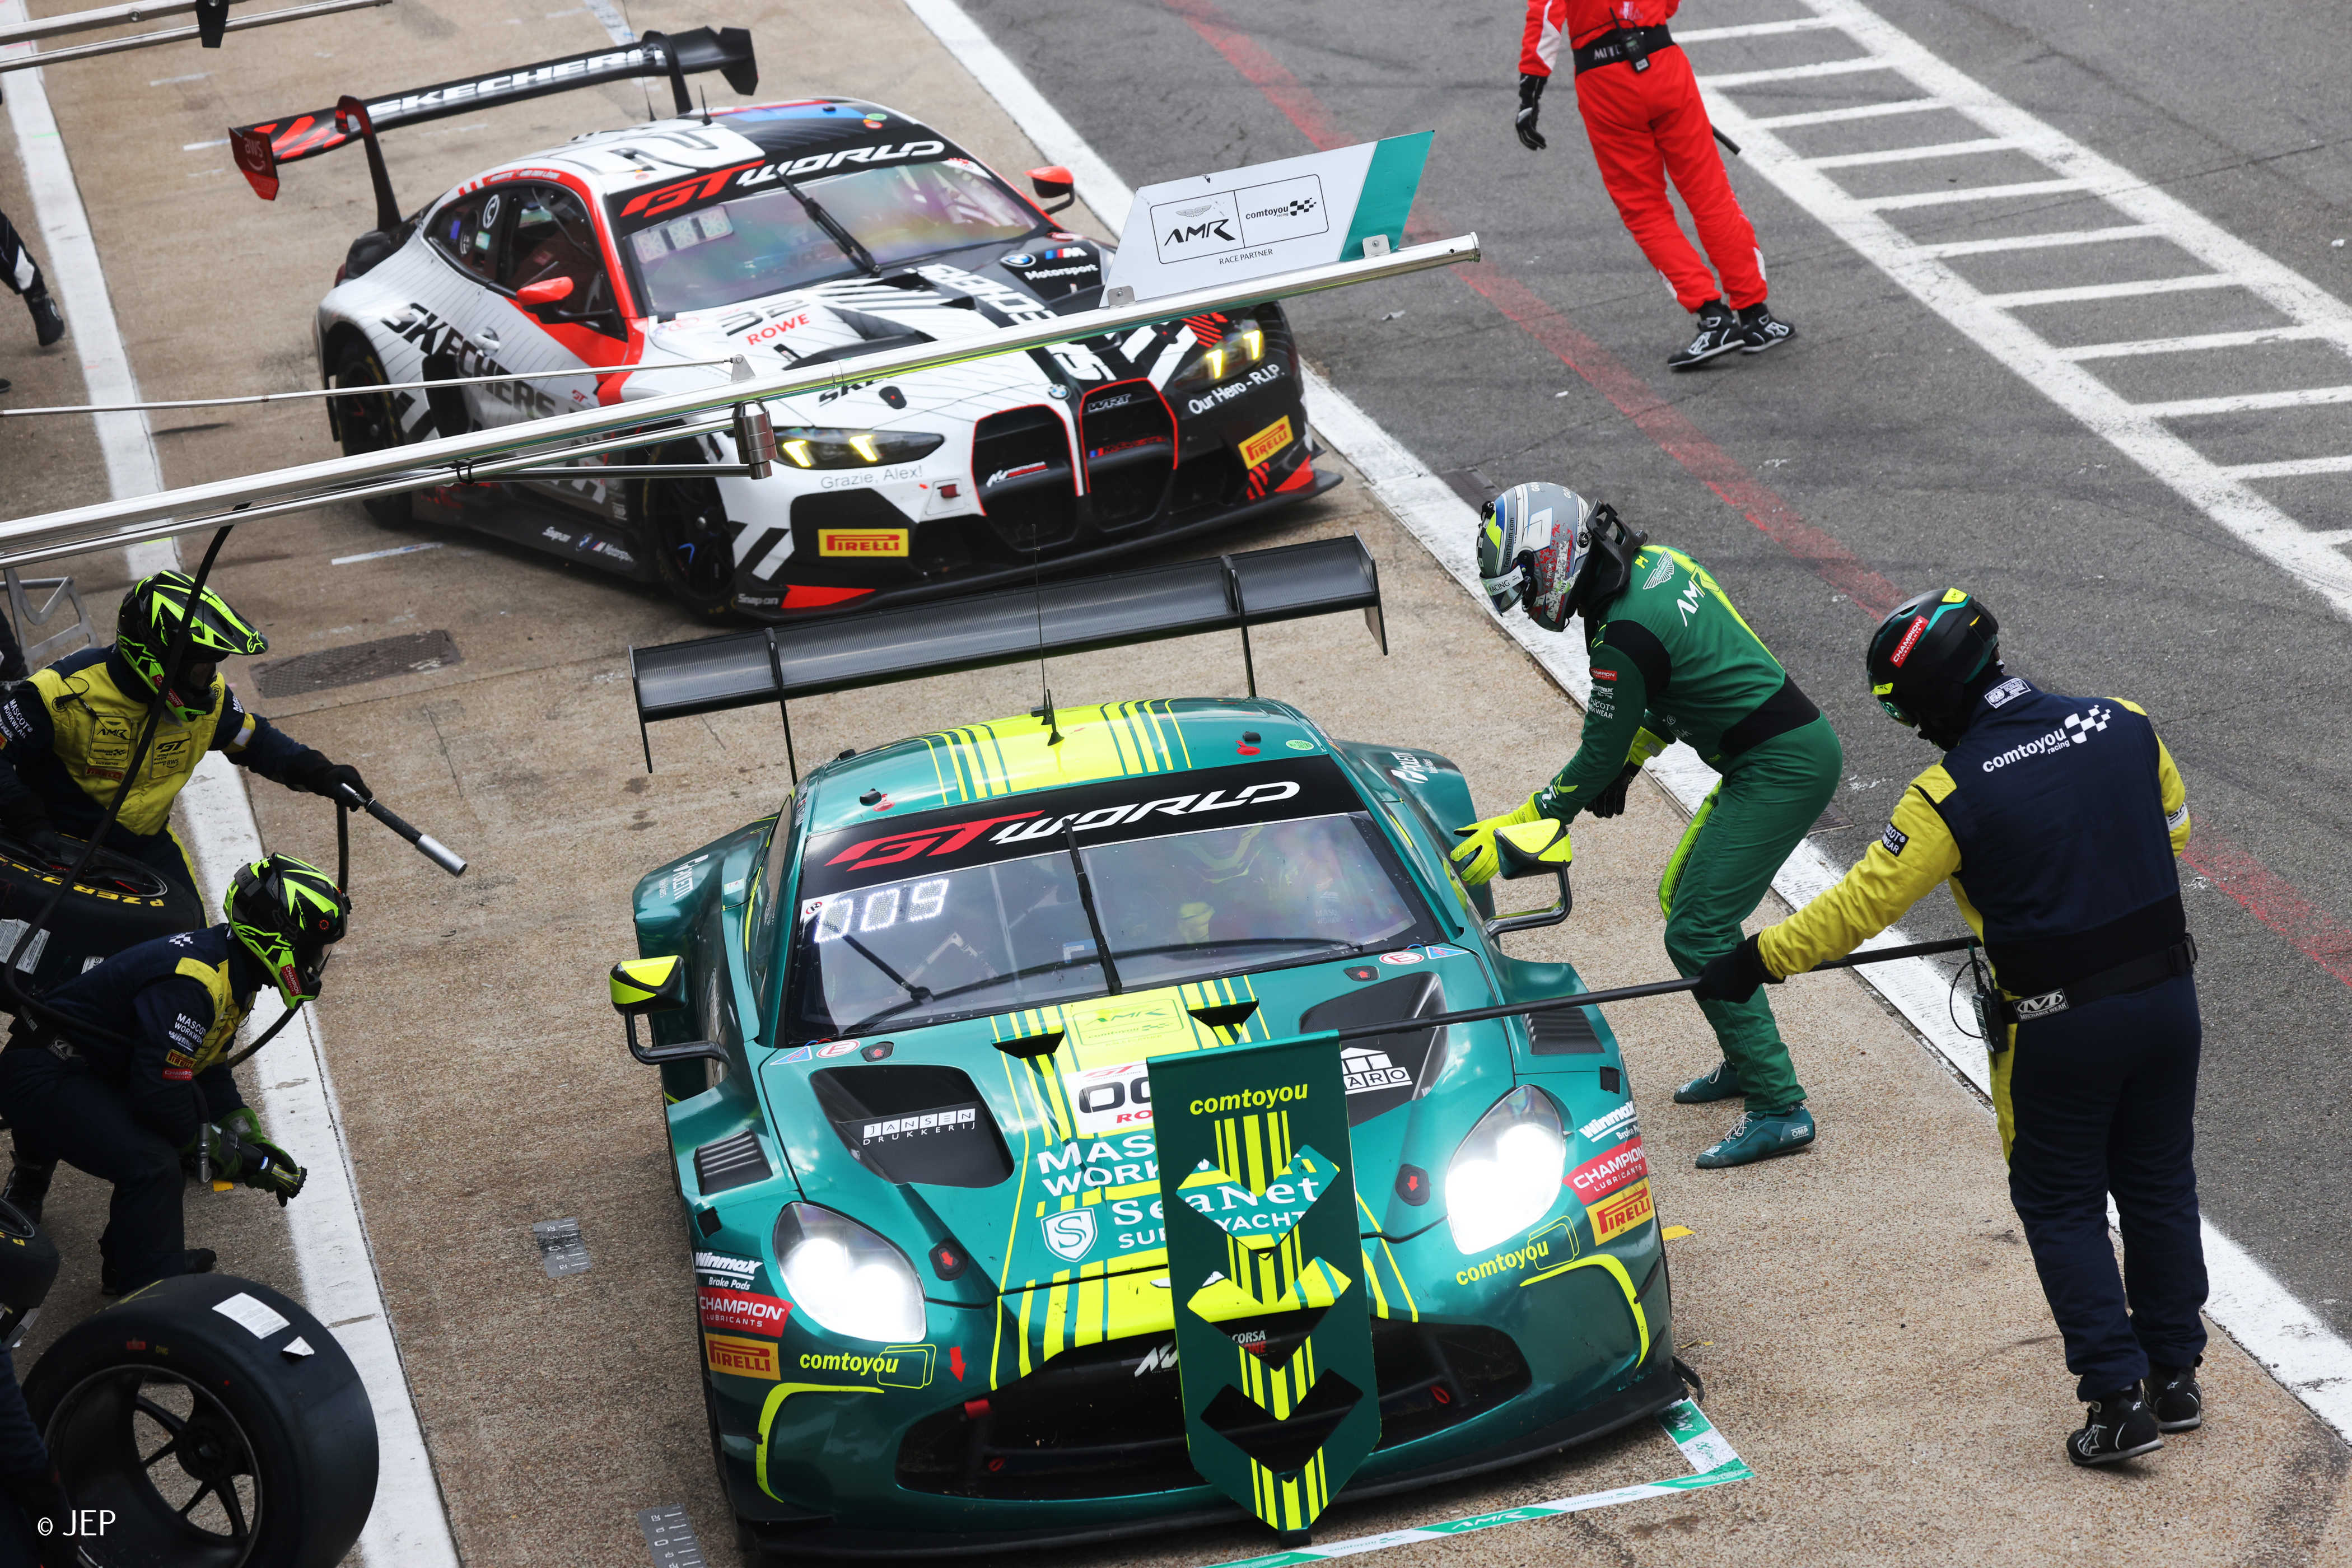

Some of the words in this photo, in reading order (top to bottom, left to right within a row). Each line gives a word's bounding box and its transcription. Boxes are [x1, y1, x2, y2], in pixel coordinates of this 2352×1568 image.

[619, 159, 766, 218] GT
[736, 140, 945, 186] WORLD
[1164, 218, 1236, 246] AMR
[1245, 206, 1289, 220] comtoyou
[1219, 255, 1239, 265] RACE
[1240, 248, 1273, 260] PARTNER
[1024, 263, 1099, 281] Motorsport
[745, 313, 810, 346] ROWE
[1087, 393, 1132, 413] WRT
[1188, 395, 1215, 414] Our
[1211, 382, 1247, 403] Hero
[1245, 423, 1288, 461] PIRELLI
[820, 471, 879, 489] Grazie,
[883, 465, 923, 481] Alex!
[826, 534, 900, 552] PIRELLI
[1892, 618, 1923, 663] CHAMPION
[97, 728, 128, 740] AMR
[156, 738, 191, 753] GT
[2047, 739, 2070, 755] racing
[1982, 727, 2066, 773] comtoyou
[824, 810, 1044, 871] GT
[988, 780, 1301, 844] WORLD
[814, 879, 949, 942] 009
[285, 965, 301, 995] CHAMPION
[2019, 1010, 2048, 1020] MECHANIX
[2048, 1002, 2067, 1014] WEAR
[1189, 1083, 1309, 1116] comtoyou
[863, 1122, 976, 1145] DRUKKERIJ
[864, 1109, 976, 1138] JANSEN
[1572, 1145, 1644, 1189] CHAMPION
[1593, 1164, 1643, 1192] LUBRICANTS
[1597, 1188, 1651, 1235] PIRELLI
[696, 1251, 763, 1276] Winmax
[1456, 1240, 1550, 1286] comtoyou
[708, 1276, 728, 1287] Brake
[730, 1278, 751, 1291] Pads
[699, 1295, 783, 1320] CHAMPION
[706, 1313, 763, 1328] LUBRICANTS
[709, 1340, 771, 1372] PIRELLI
[799, 1351, 899, 1374] comtoyou
